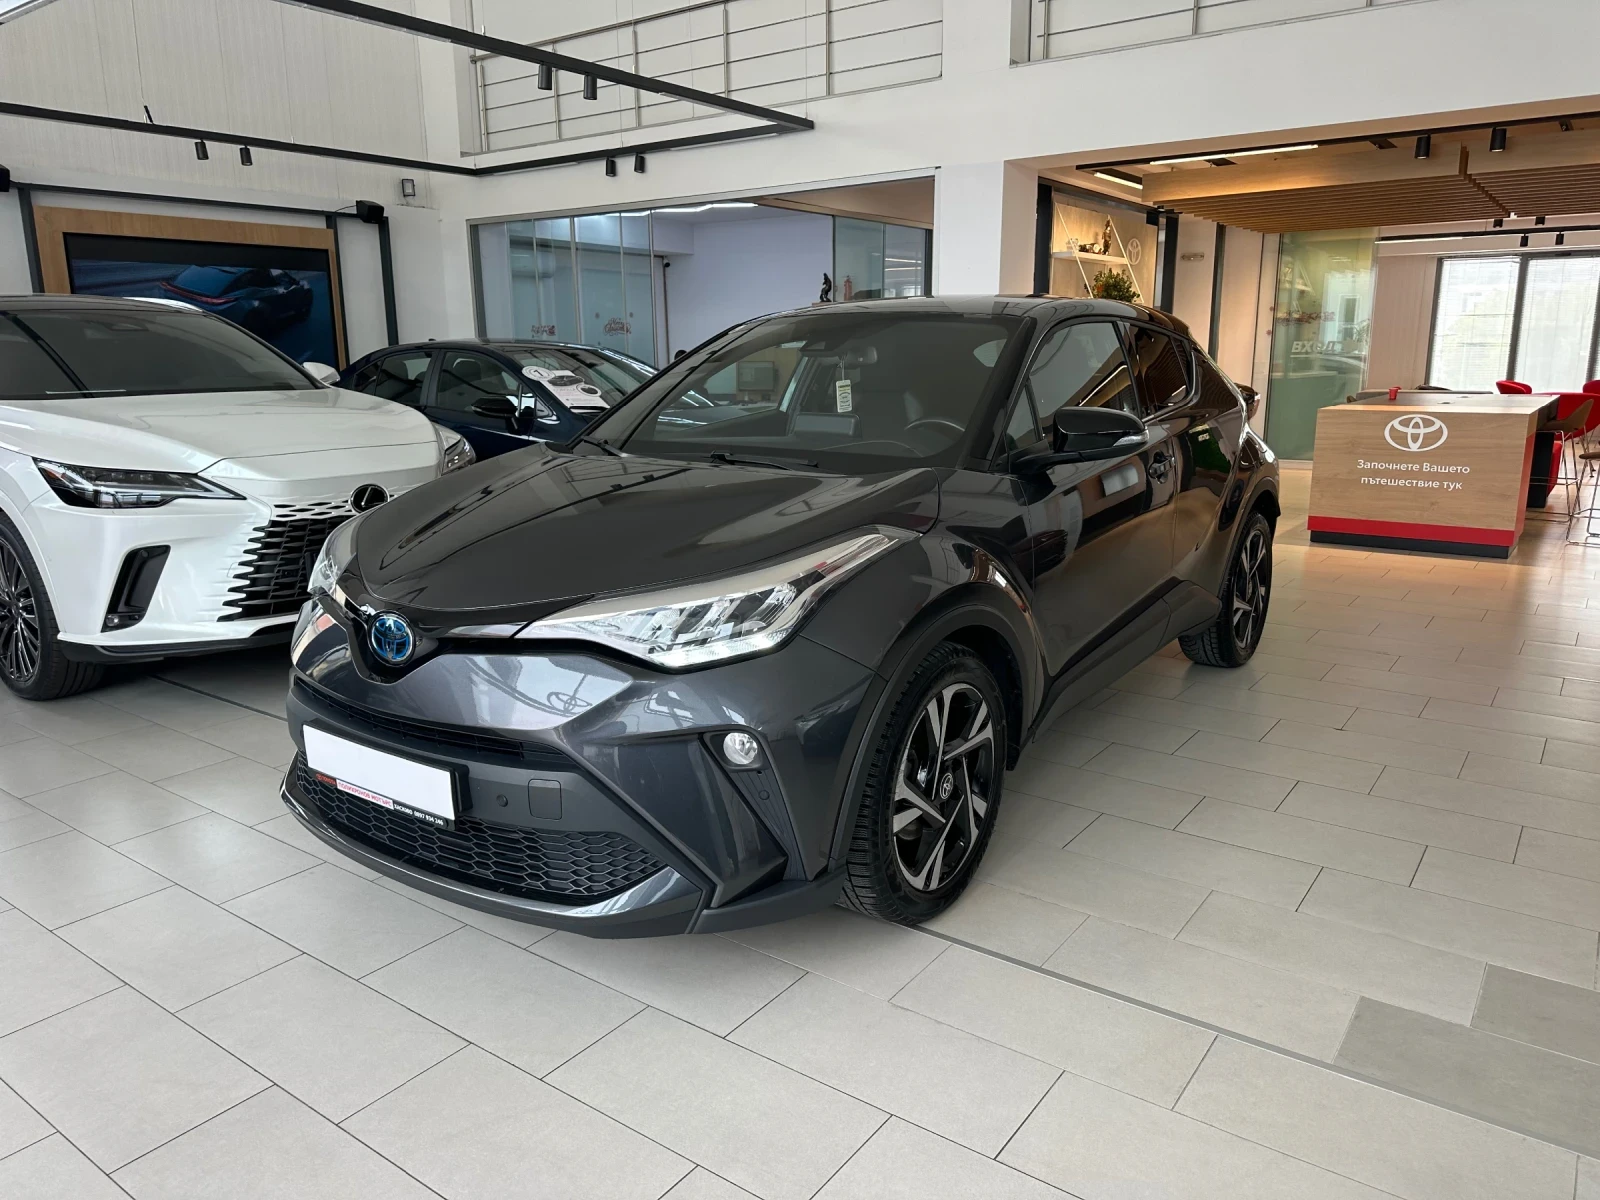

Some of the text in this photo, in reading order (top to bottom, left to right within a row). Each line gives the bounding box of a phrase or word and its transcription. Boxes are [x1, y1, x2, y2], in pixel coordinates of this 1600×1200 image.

[1356, 459, 1471, 474] Започнете Вашето
[1360, 476, 1463, 491] пътешествие тук
